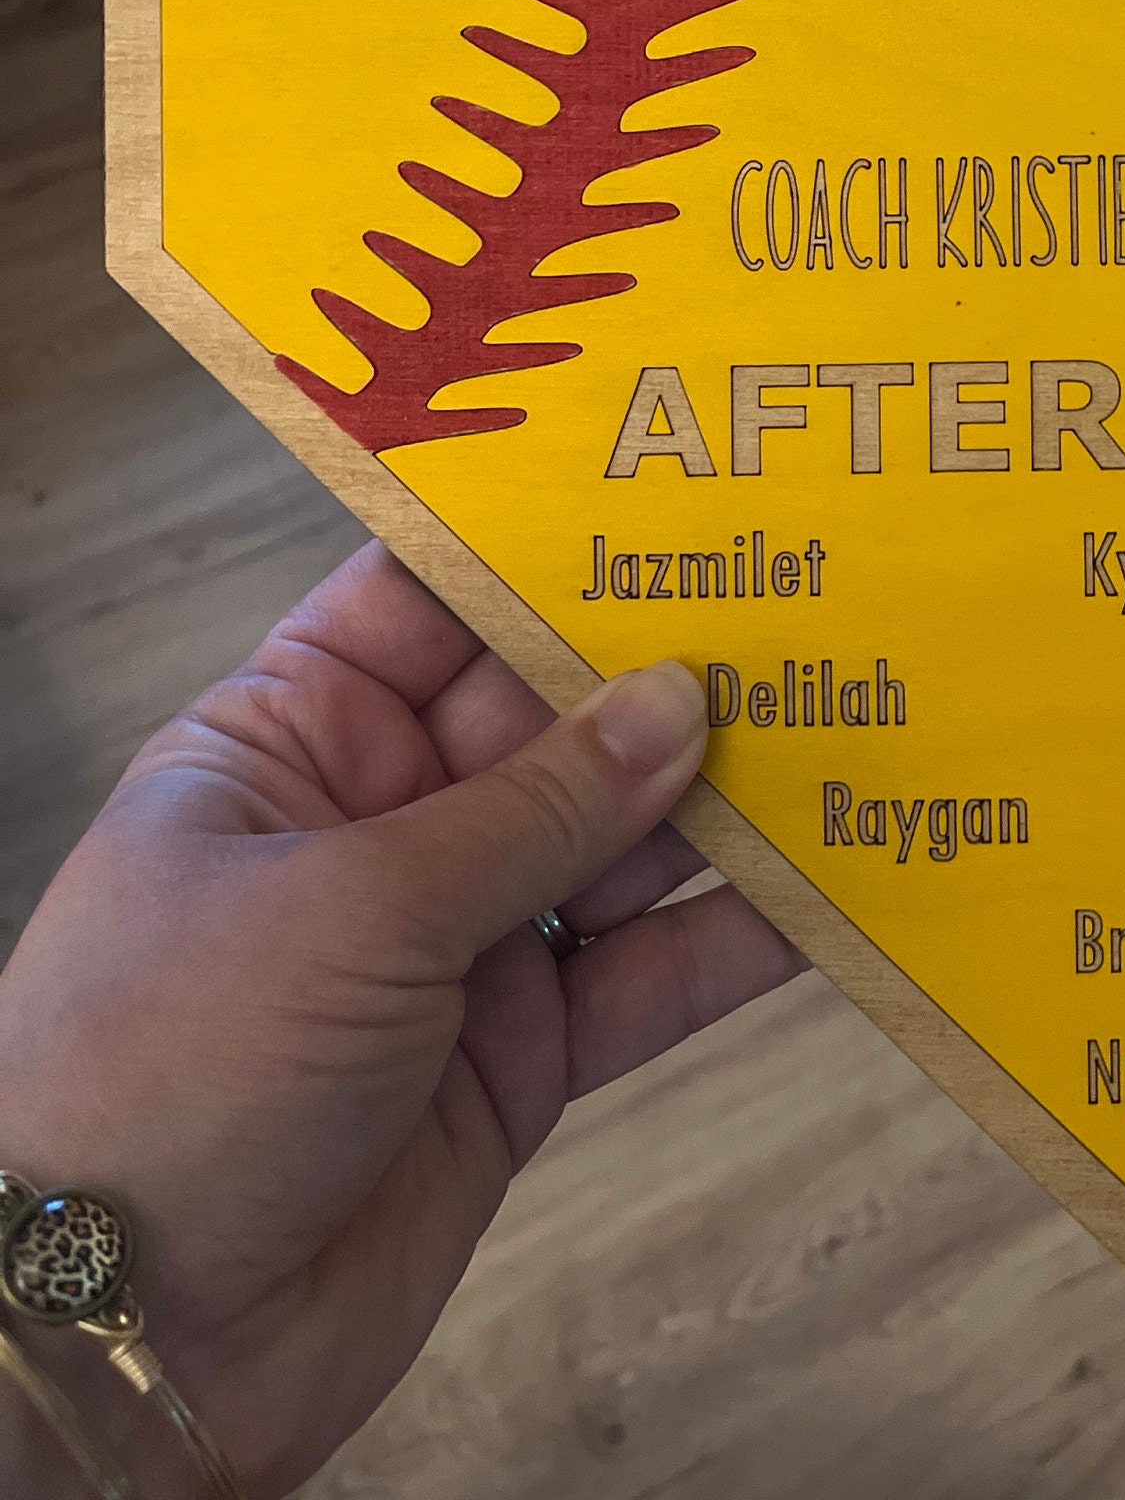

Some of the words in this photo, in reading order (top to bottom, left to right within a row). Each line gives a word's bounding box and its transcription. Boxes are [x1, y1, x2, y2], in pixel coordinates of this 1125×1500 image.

[731, 157, 909, 272] COACH
[582, 530, 826, 601] Jazmilet
[707, 659, 906, 727] Delilah
[823, 781, 1028, 864] Raygan
